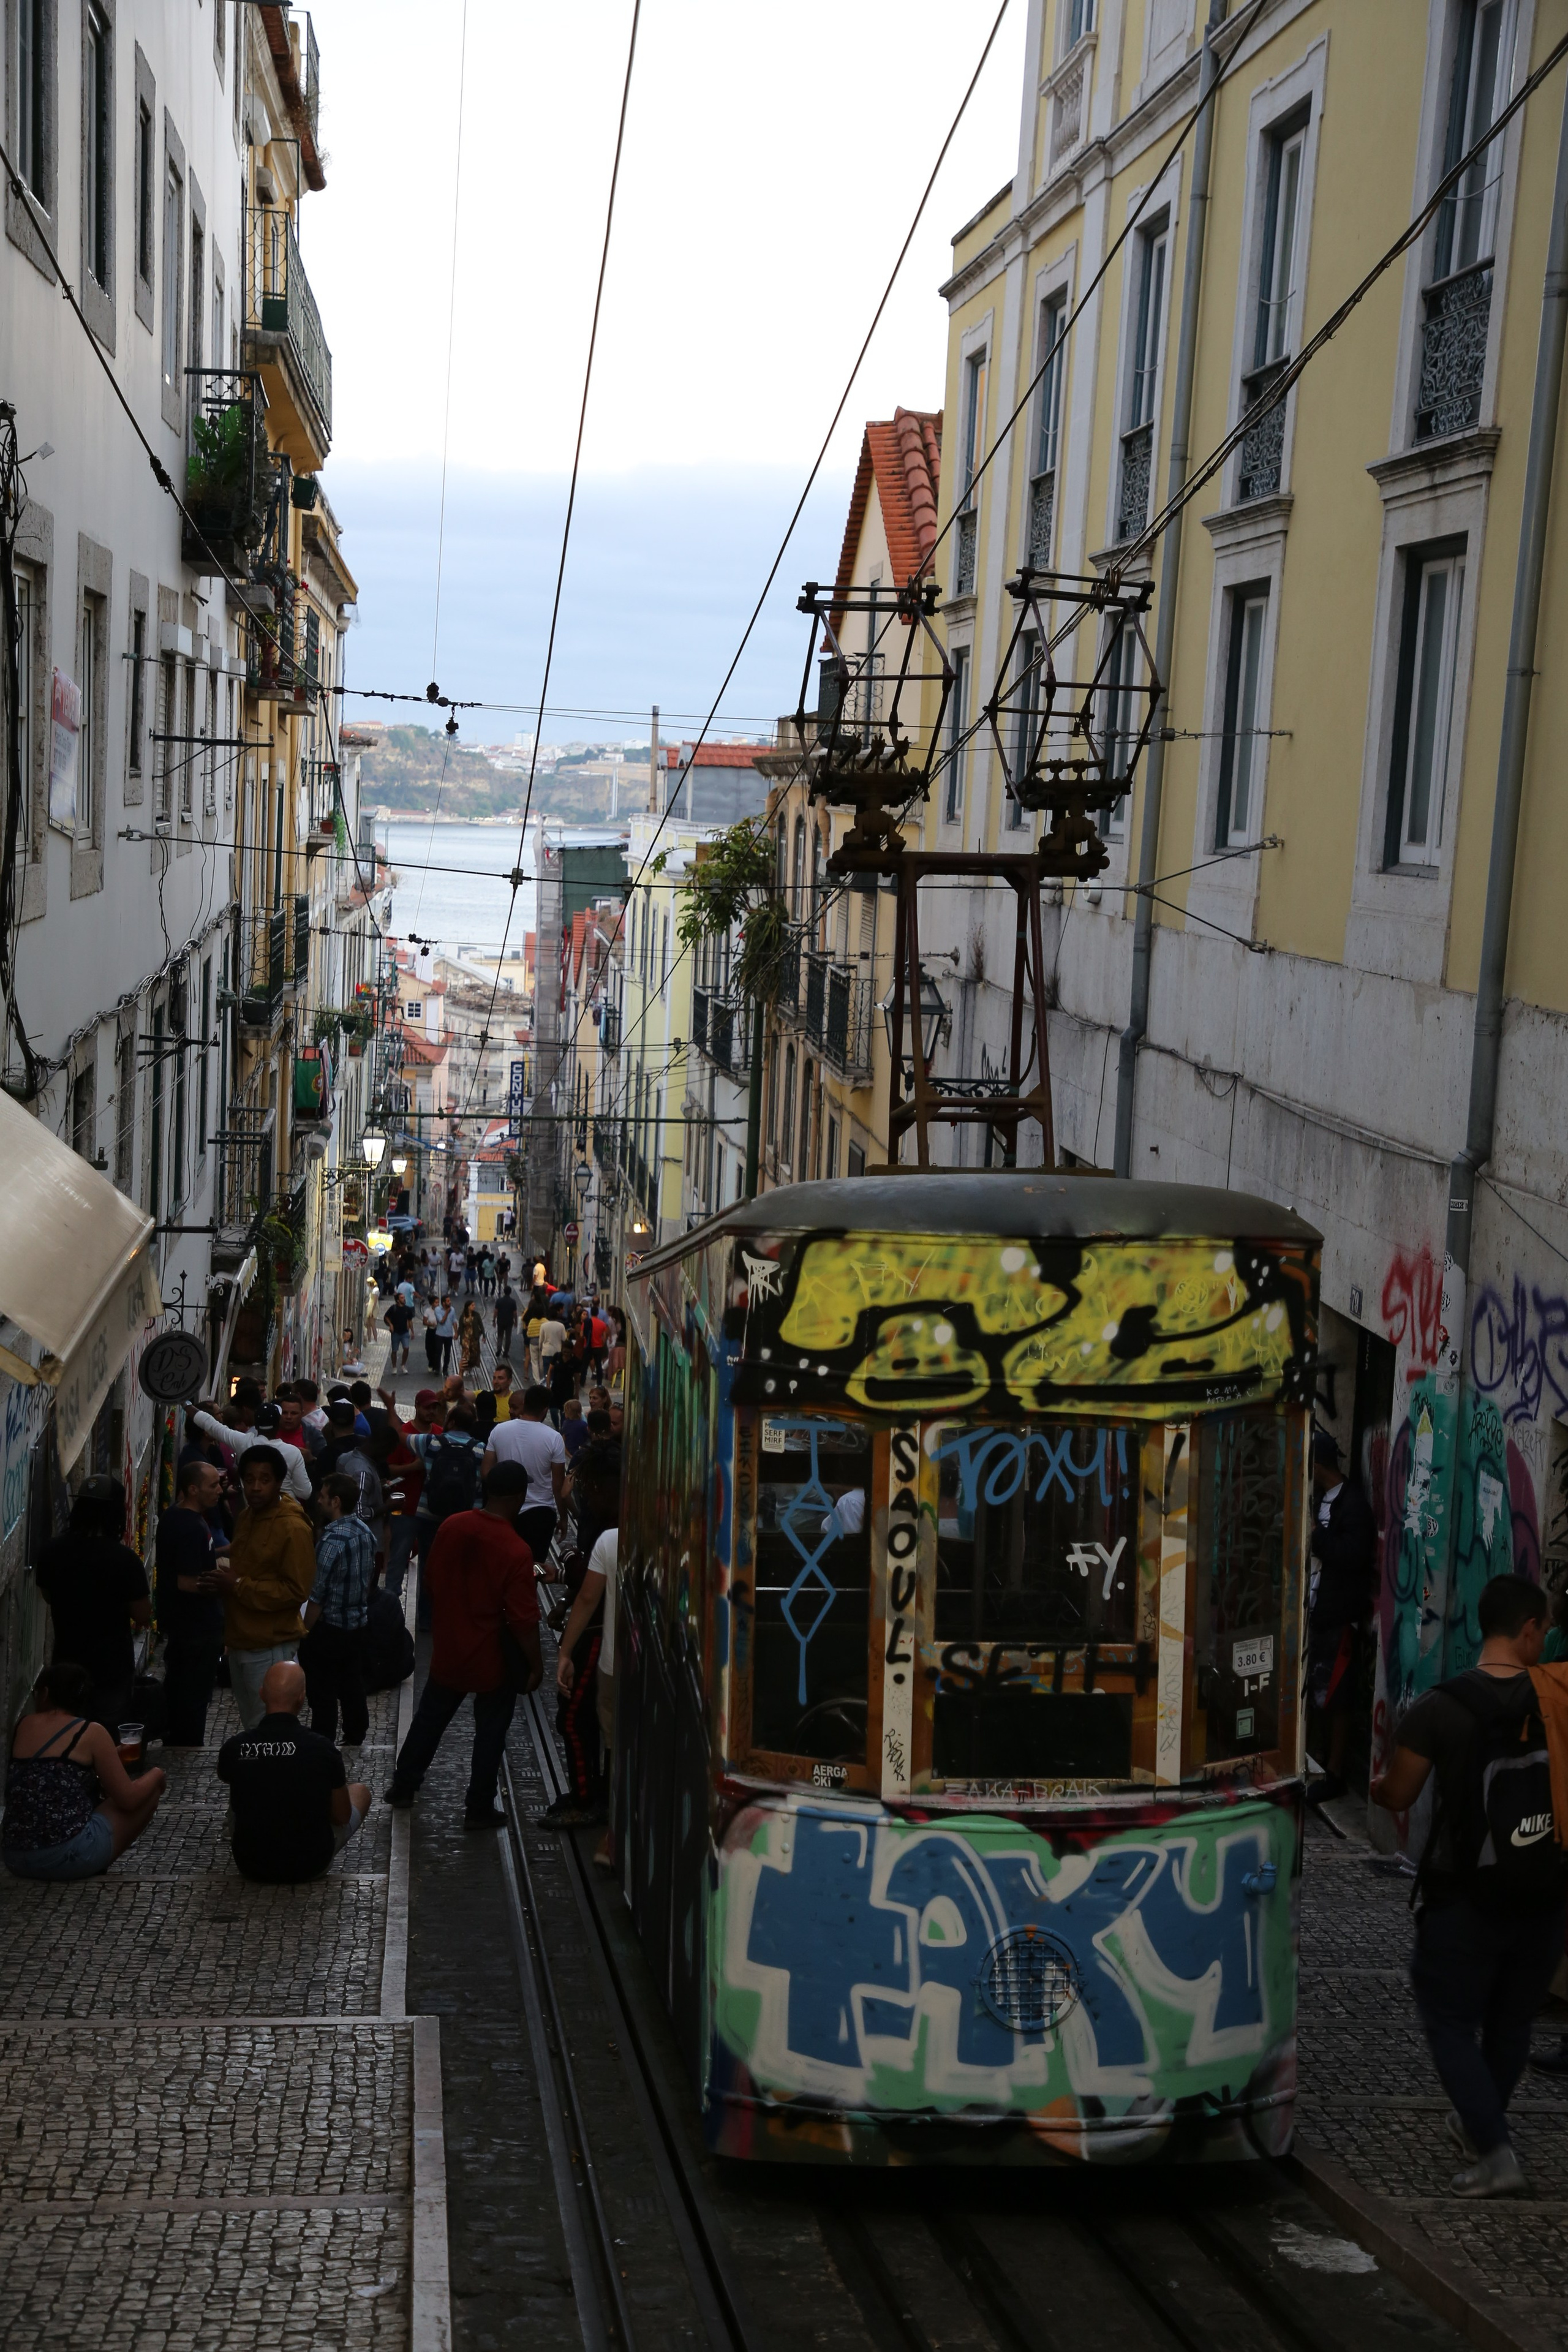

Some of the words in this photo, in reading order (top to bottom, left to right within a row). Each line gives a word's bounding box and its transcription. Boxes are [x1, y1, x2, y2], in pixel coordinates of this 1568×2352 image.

[1351, 1290, 1360, 1314] 79
[1237, 1653, 1257, 1667] 3.80
[1259, 1651, 1265, 1662] €
[813, 1764, 848, 1778] AERGA
[1519, 1812, 1552, 1833] NIKE
